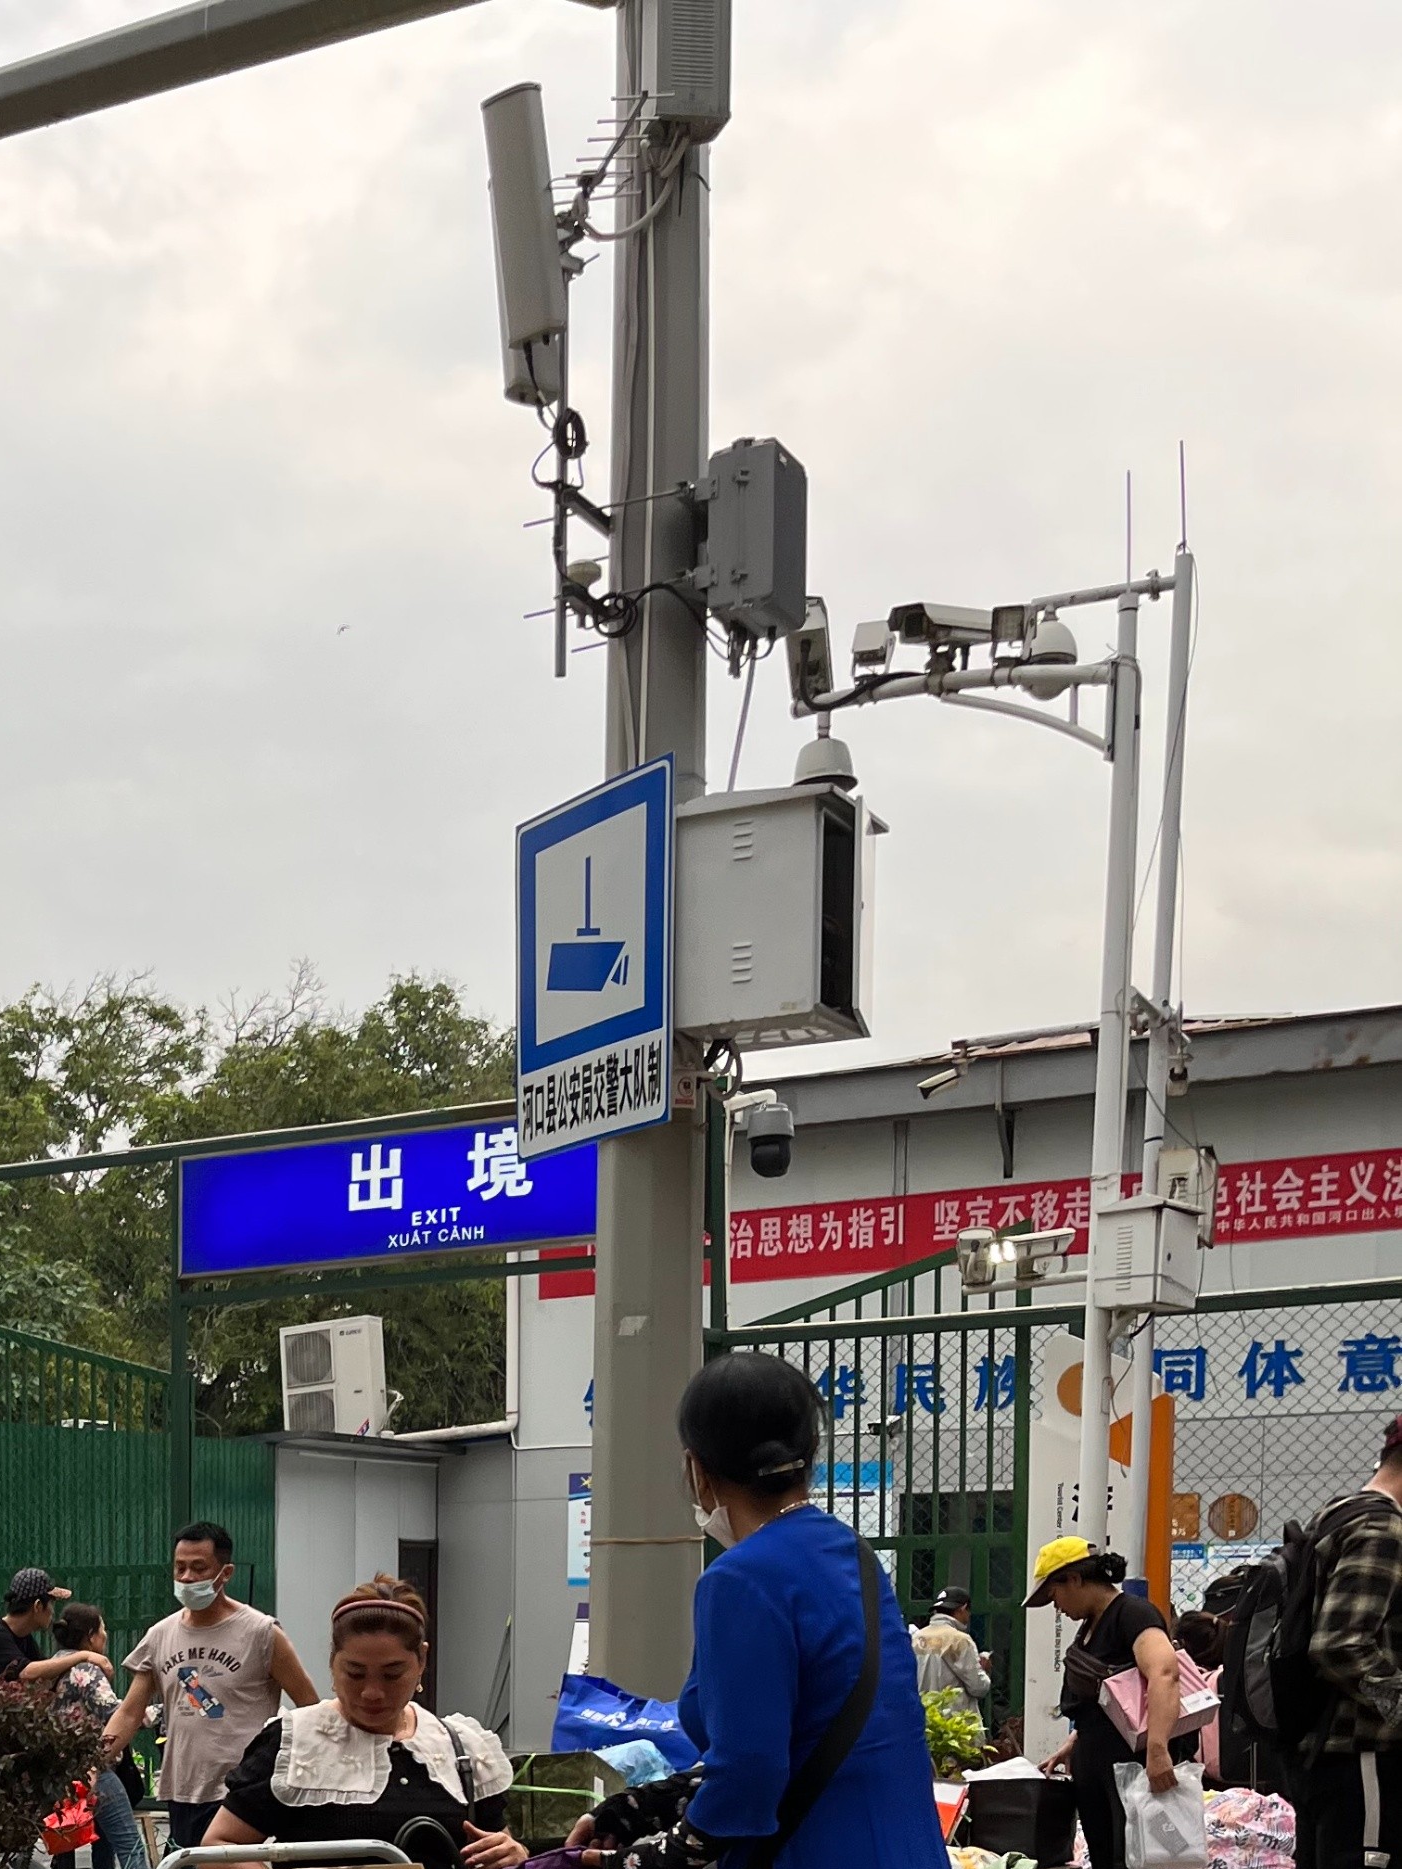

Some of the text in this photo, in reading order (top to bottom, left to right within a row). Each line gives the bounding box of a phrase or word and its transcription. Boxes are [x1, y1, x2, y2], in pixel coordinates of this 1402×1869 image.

[522, 1038, 662, 1143] 河口县公安局交警大队制
[348, 1126, 534, 1212] 出境
[411, 1206, 461, 1226] EXIT
[188, 1647, 205, 1660] ME
[208, 1648, 241, 1672] HAND
